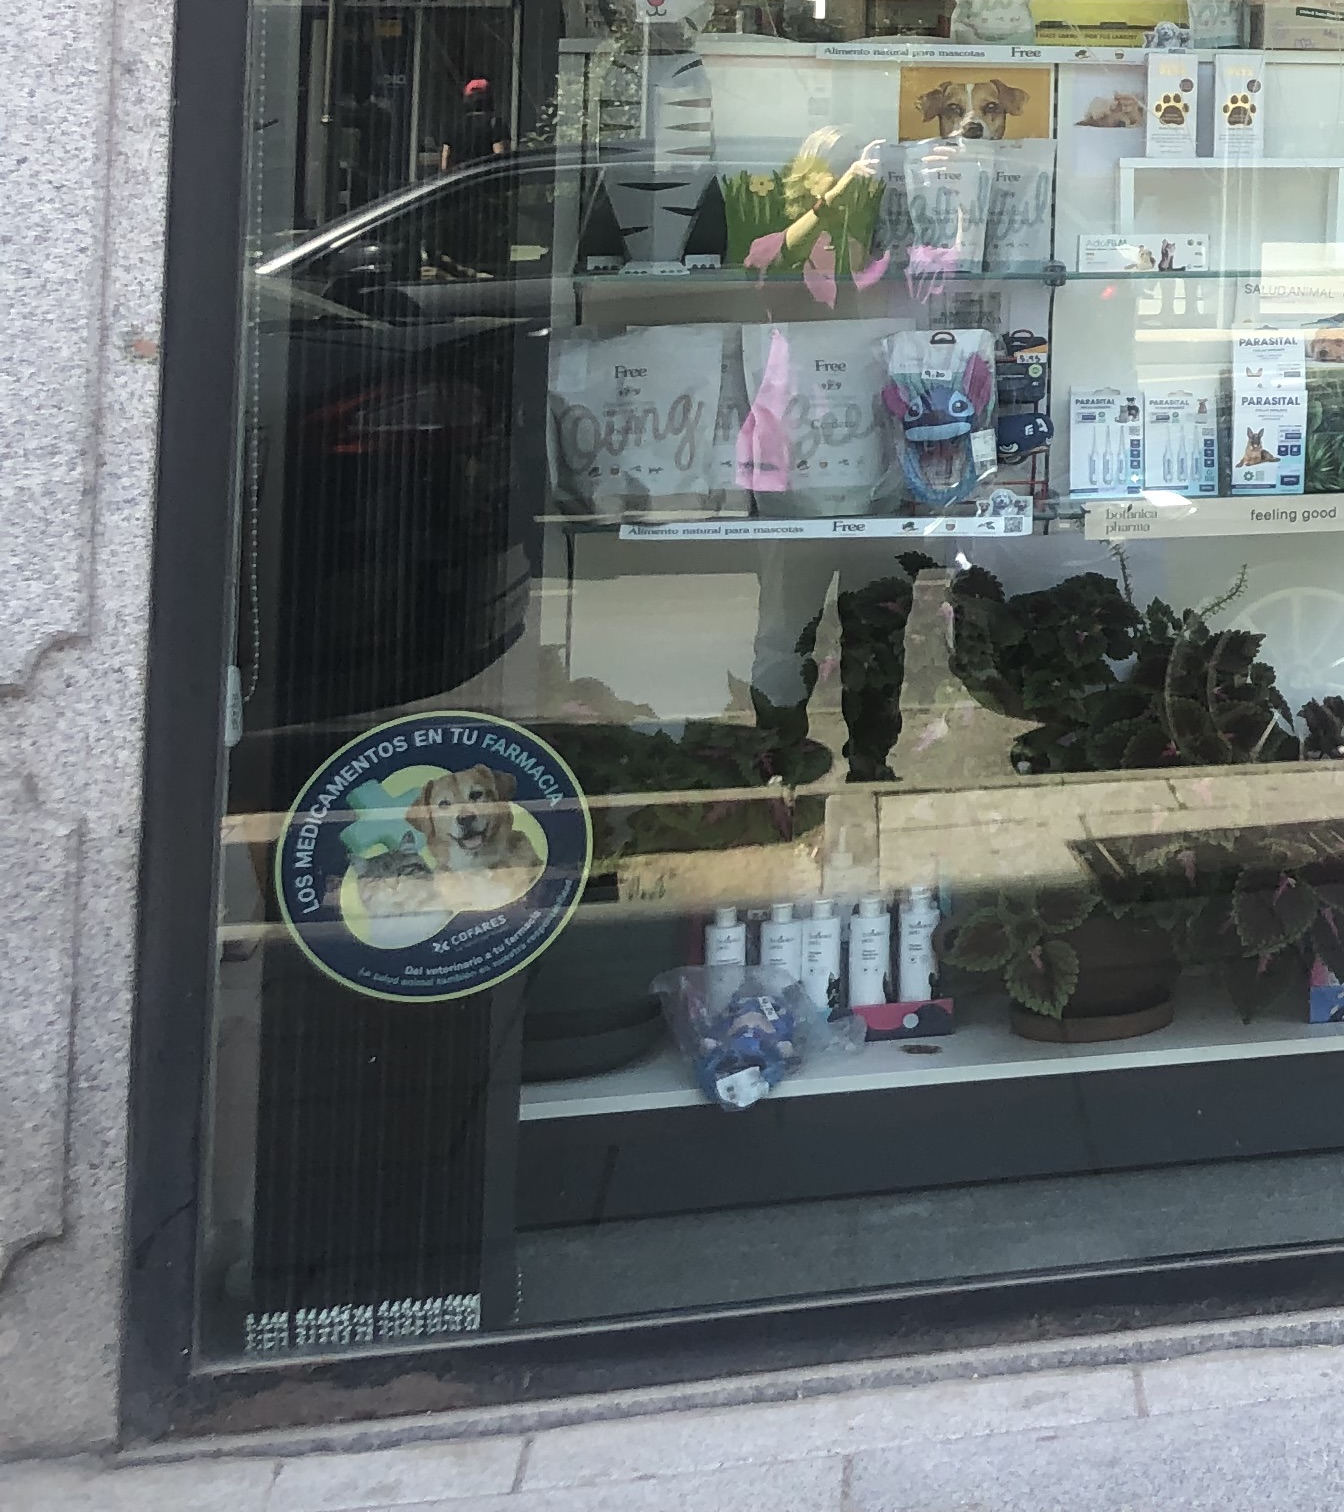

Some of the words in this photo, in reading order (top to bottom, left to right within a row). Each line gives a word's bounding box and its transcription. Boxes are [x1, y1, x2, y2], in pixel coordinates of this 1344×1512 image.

[1011, 46, 1042, 58] Free
[995, 171, 1022, 182] Free
[1244, 284, 1288, 296] SALUD
[1289, 285, 1335, 299] ANIMAL
[1238, 336, 1298, 347] PARASITAL
[614, 365, 648, 379] Free
[815, 359, 847, 372] Free
[1241, 396, 1301, 406] PARASITAL
[1250, 506, 1298, 523] feeling
[1301, 506, 1337, 522] good
[628, 526, 679, 536] Alimento
[681, 526, 722, 536] natural
[724, 527, 750, 538] para
[752, 525, 805, 535] mascotas
[831, 520, 866, 533] Free
[1105, 521, 1151, 535] pharma
[413, 727, 444, 748] EN
[449, 727, 478, 747] TU
[481, 732, 566, 809] FARMACIA
[295, 734, 409, 870] MEDICAMENTOS
[295, 873, 320, 914] LOS
[451, 914, 507, 946] COFARES
